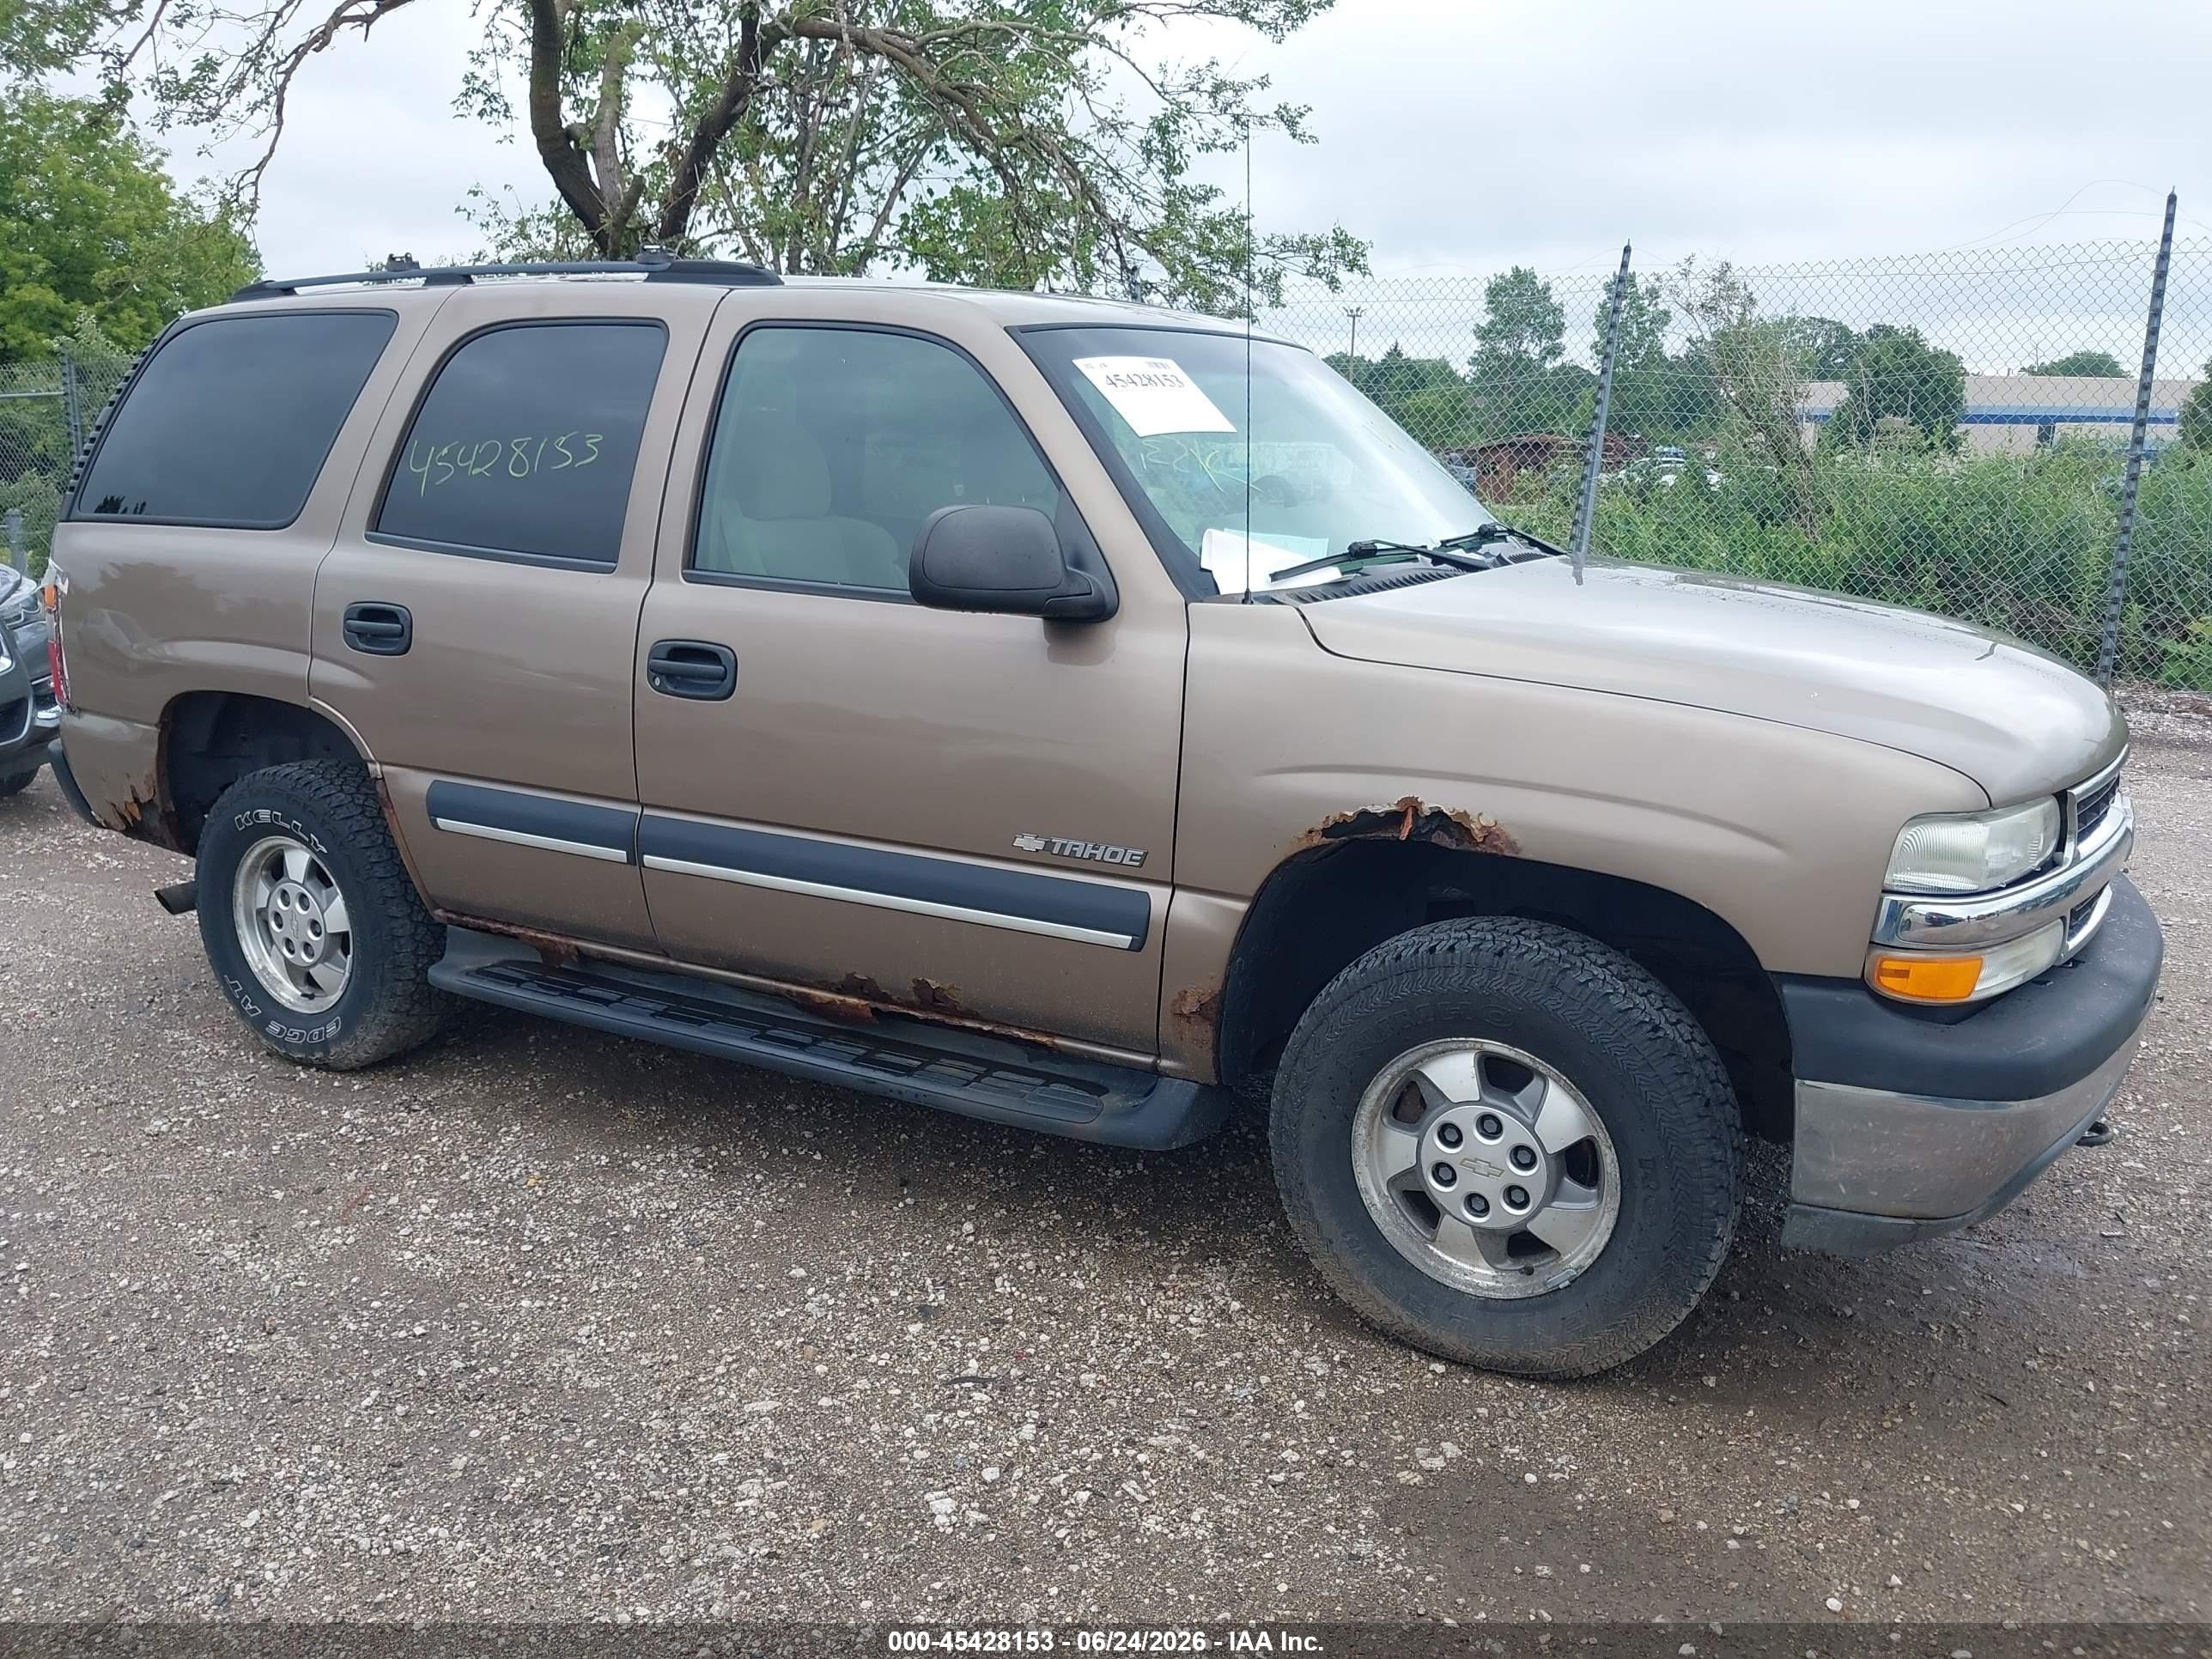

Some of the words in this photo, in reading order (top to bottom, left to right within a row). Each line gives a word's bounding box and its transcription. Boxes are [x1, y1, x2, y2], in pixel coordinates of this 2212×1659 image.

[1105, 373, 1186, 389] 45428153
[410, 430, 605, 497] 45428153
[234, 808, 329, 854] KELLY
[1050, 836, 1149, 868] TAHOE
[265, 1016, 342, 1043] EDGE
